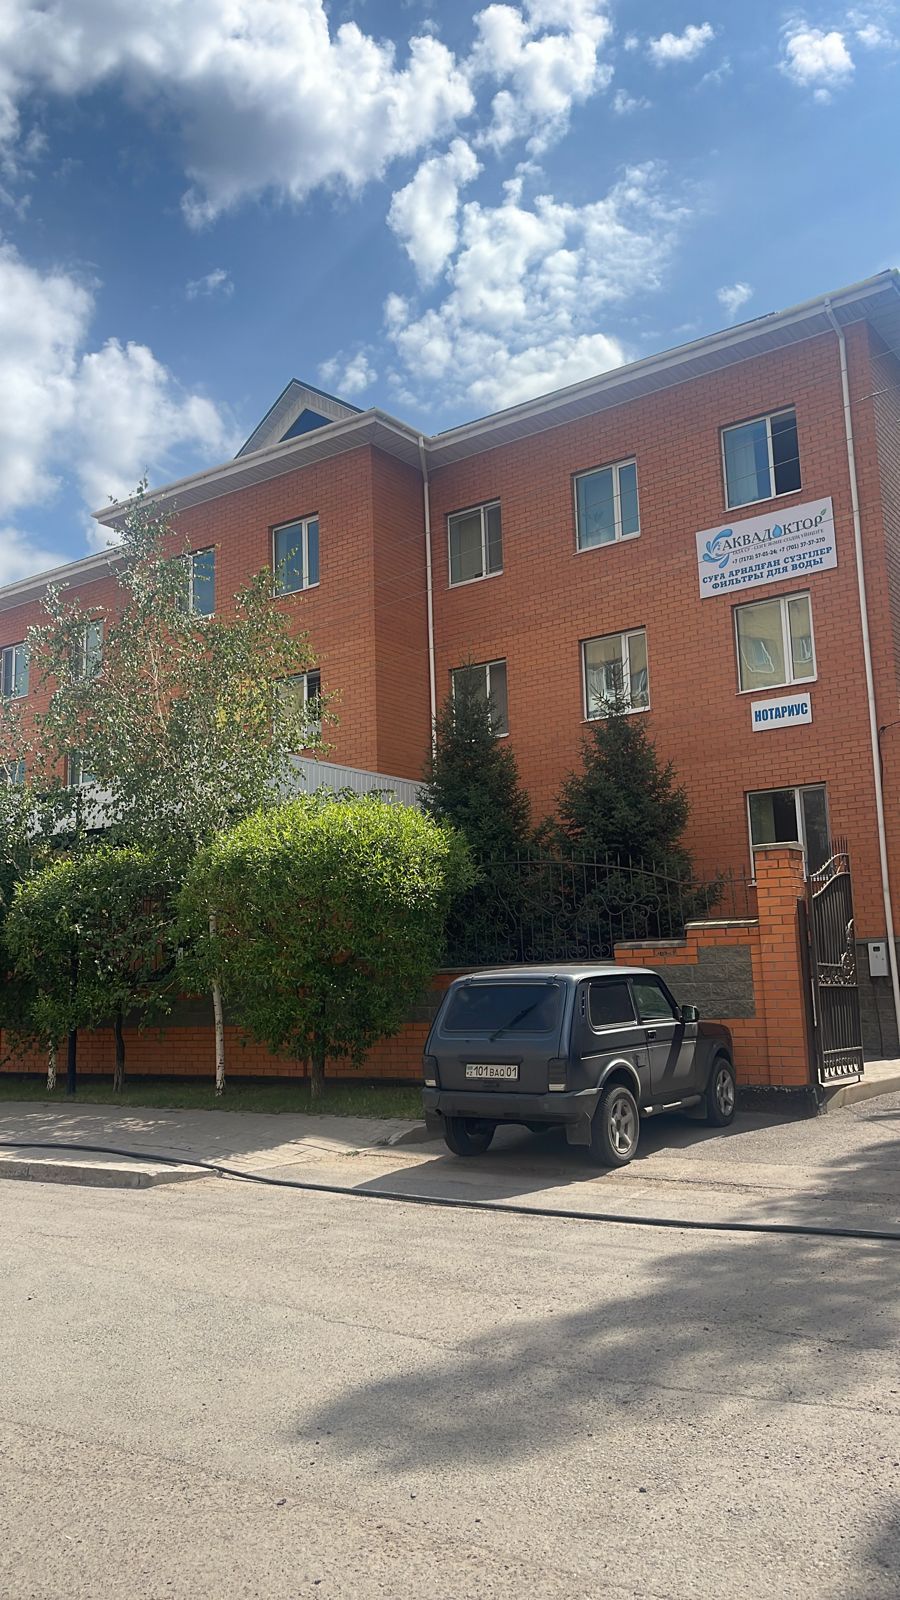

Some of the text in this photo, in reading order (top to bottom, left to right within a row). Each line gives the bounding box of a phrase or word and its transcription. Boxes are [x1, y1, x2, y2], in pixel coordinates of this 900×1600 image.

[702, 572, 726, 584] СУҒА
[728, 559, 781, 578] АРНАЛҒАН
[711, 557, 824, 590] ФИЛЬТРЫ ДЛЯ ВОДЫ
[754, 702, 808, 722] НОТАРИУС
